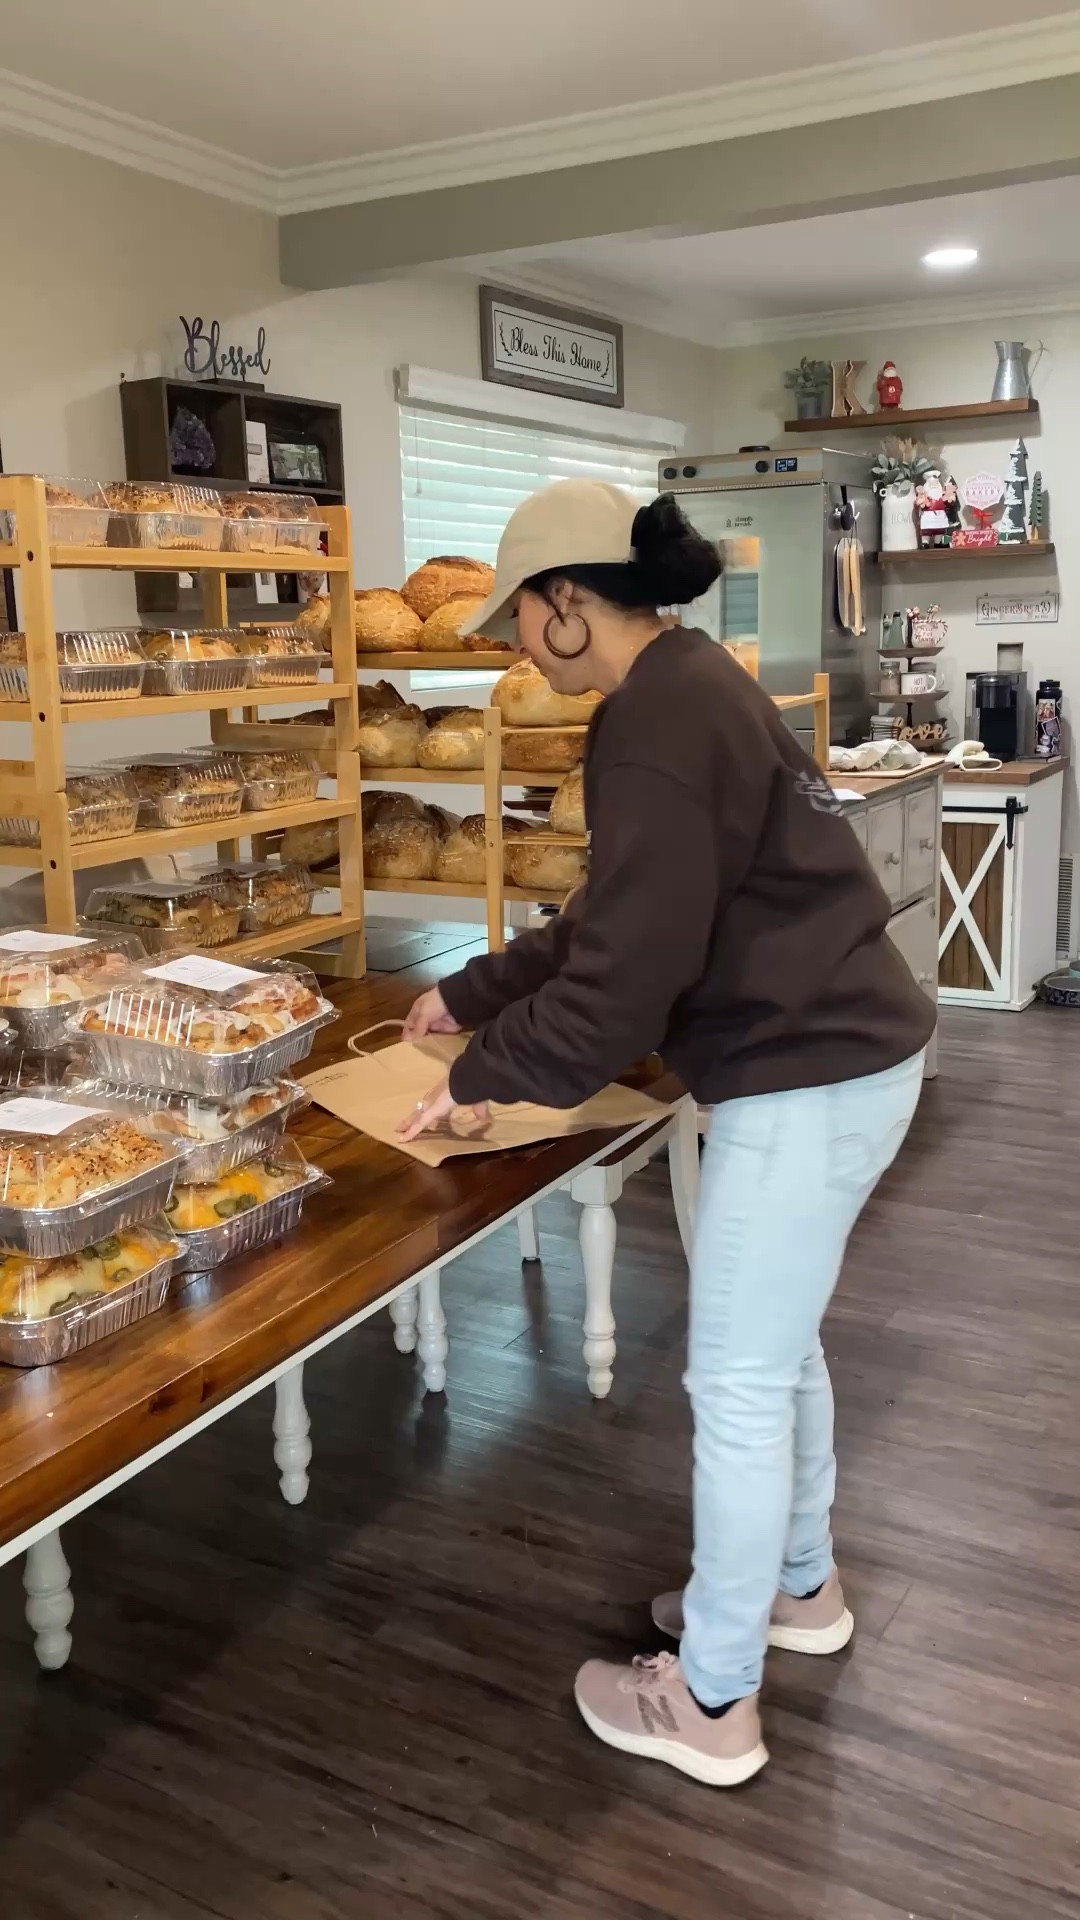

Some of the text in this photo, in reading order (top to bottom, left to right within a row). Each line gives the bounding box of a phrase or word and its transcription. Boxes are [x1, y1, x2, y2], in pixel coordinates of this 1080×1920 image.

[179, 315, 271, 376] Blessed
[511, 327, 602, 372] Bless This Home
[831, 360, 868, 417] K
[966, 534, 993, 547] Bright
[913, 677, 923, 686] HOT
